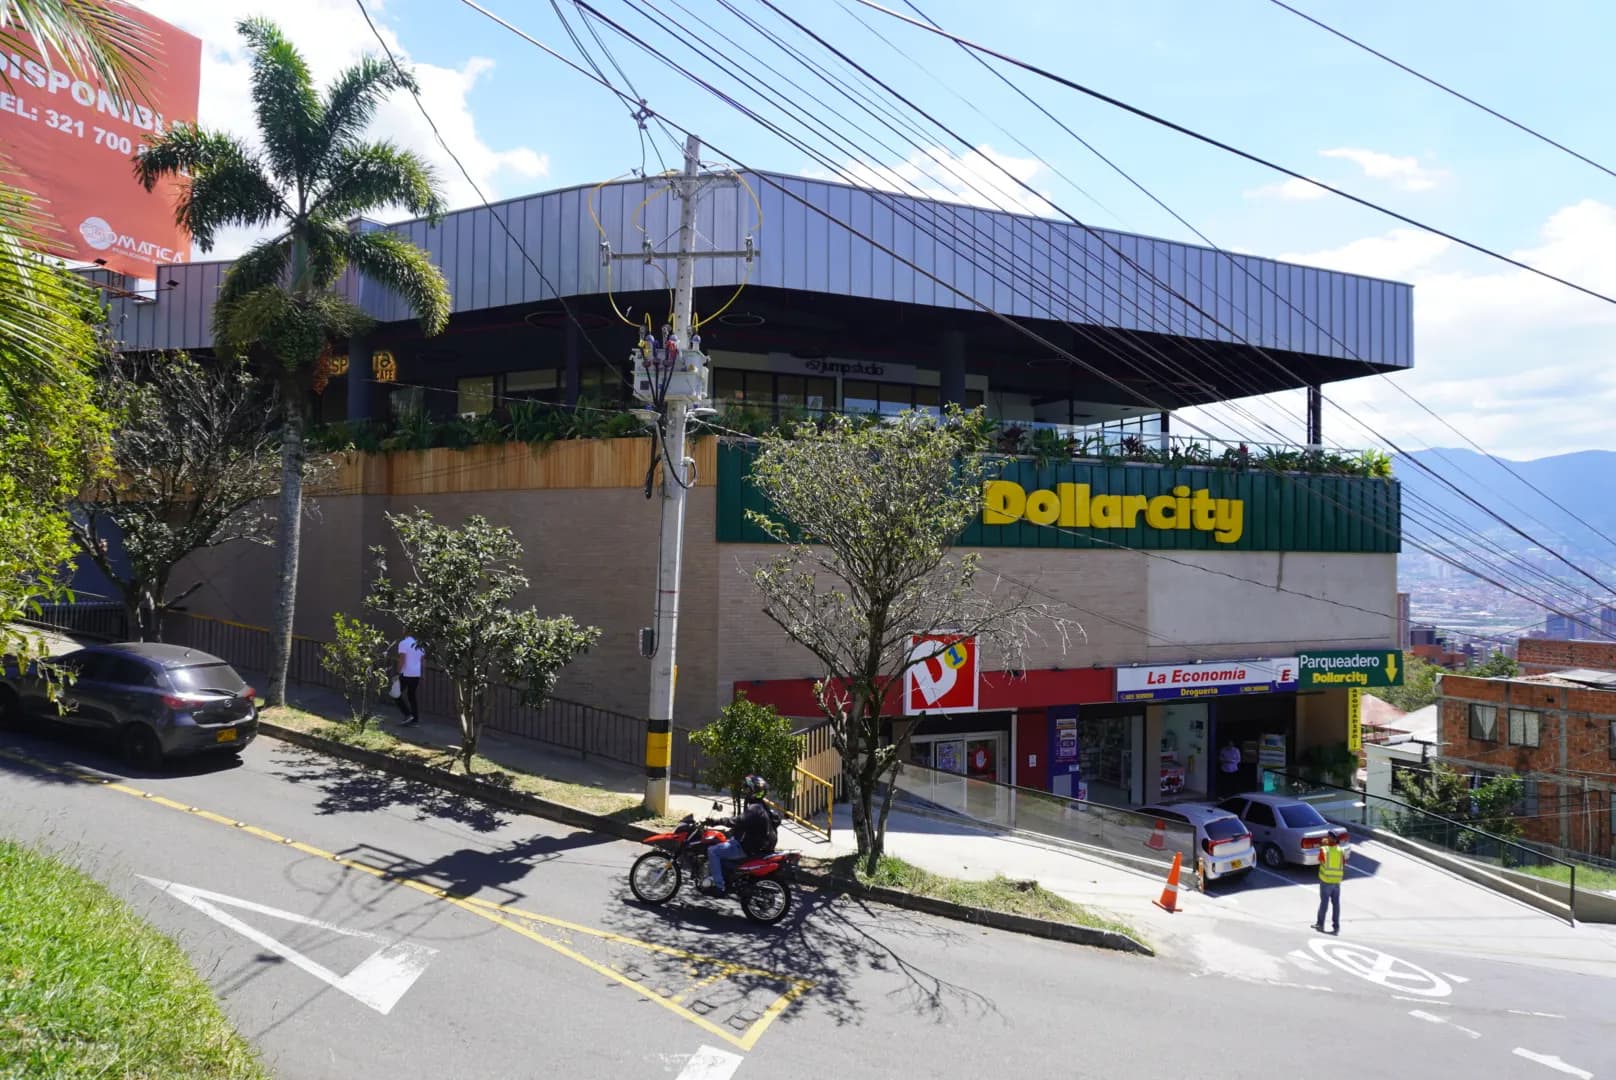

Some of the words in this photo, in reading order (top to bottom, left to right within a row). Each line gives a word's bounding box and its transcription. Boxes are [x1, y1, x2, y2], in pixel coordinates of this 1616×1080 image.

[45, 109, 84, 138] 321
[93, 126, 131, 155] 700
[983, 480, 1243, 544] Dollarcity
[1300, 653, 1380, 671] Parqueadero
[1147, 671, 1167, 685] La
[1312, 671, 1368, 685] Dollarcity
